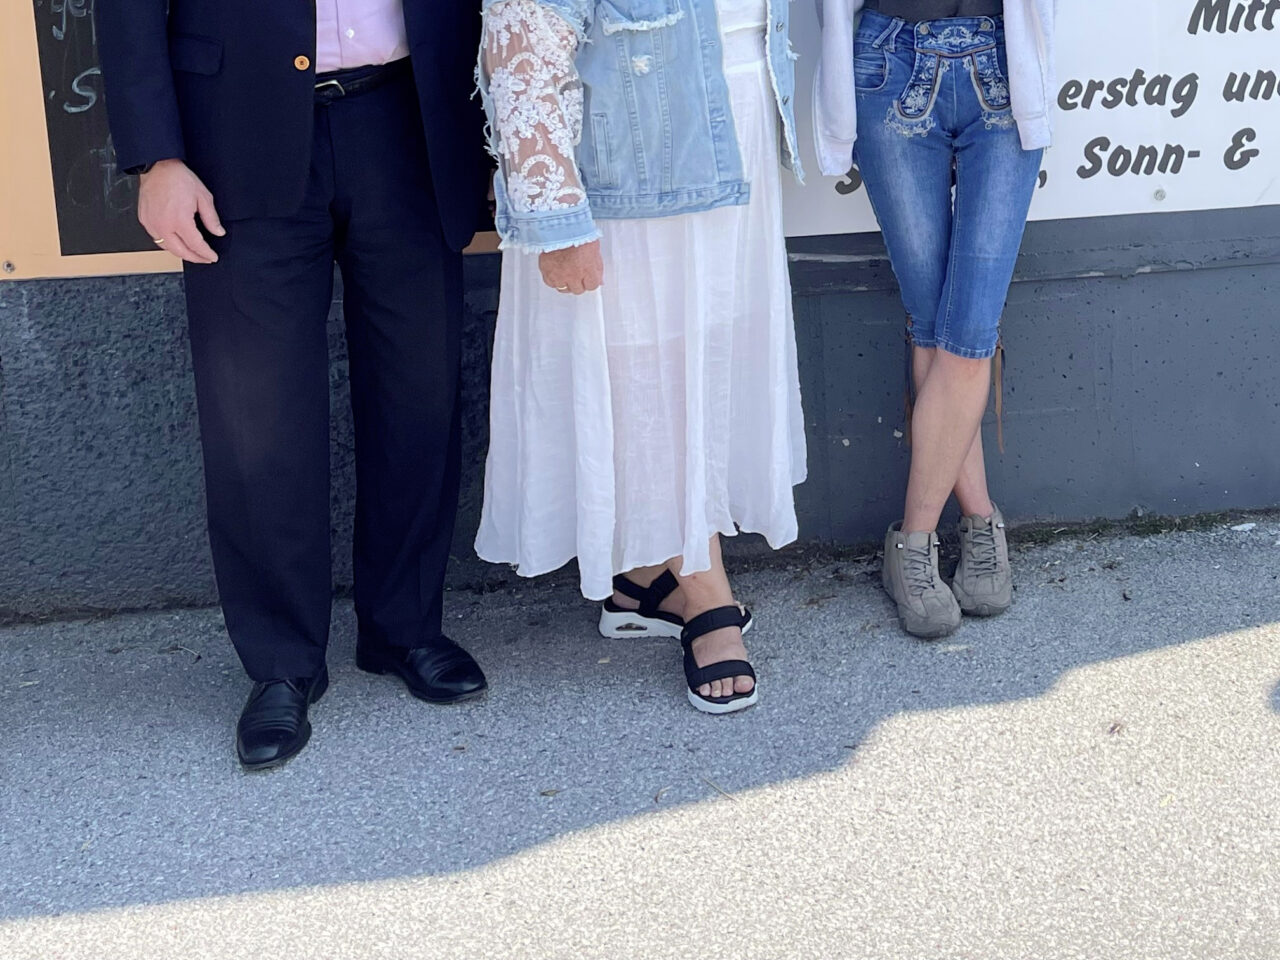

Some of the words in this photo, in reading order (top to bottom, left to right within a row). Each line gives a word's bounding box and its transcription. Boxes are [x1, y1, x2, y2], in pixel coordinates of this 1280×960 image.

[1058, 68, 1199, 118] erstag
[1077, 137, 1201, 179] Sonn-
[1224, 128, 1260, 171] &
